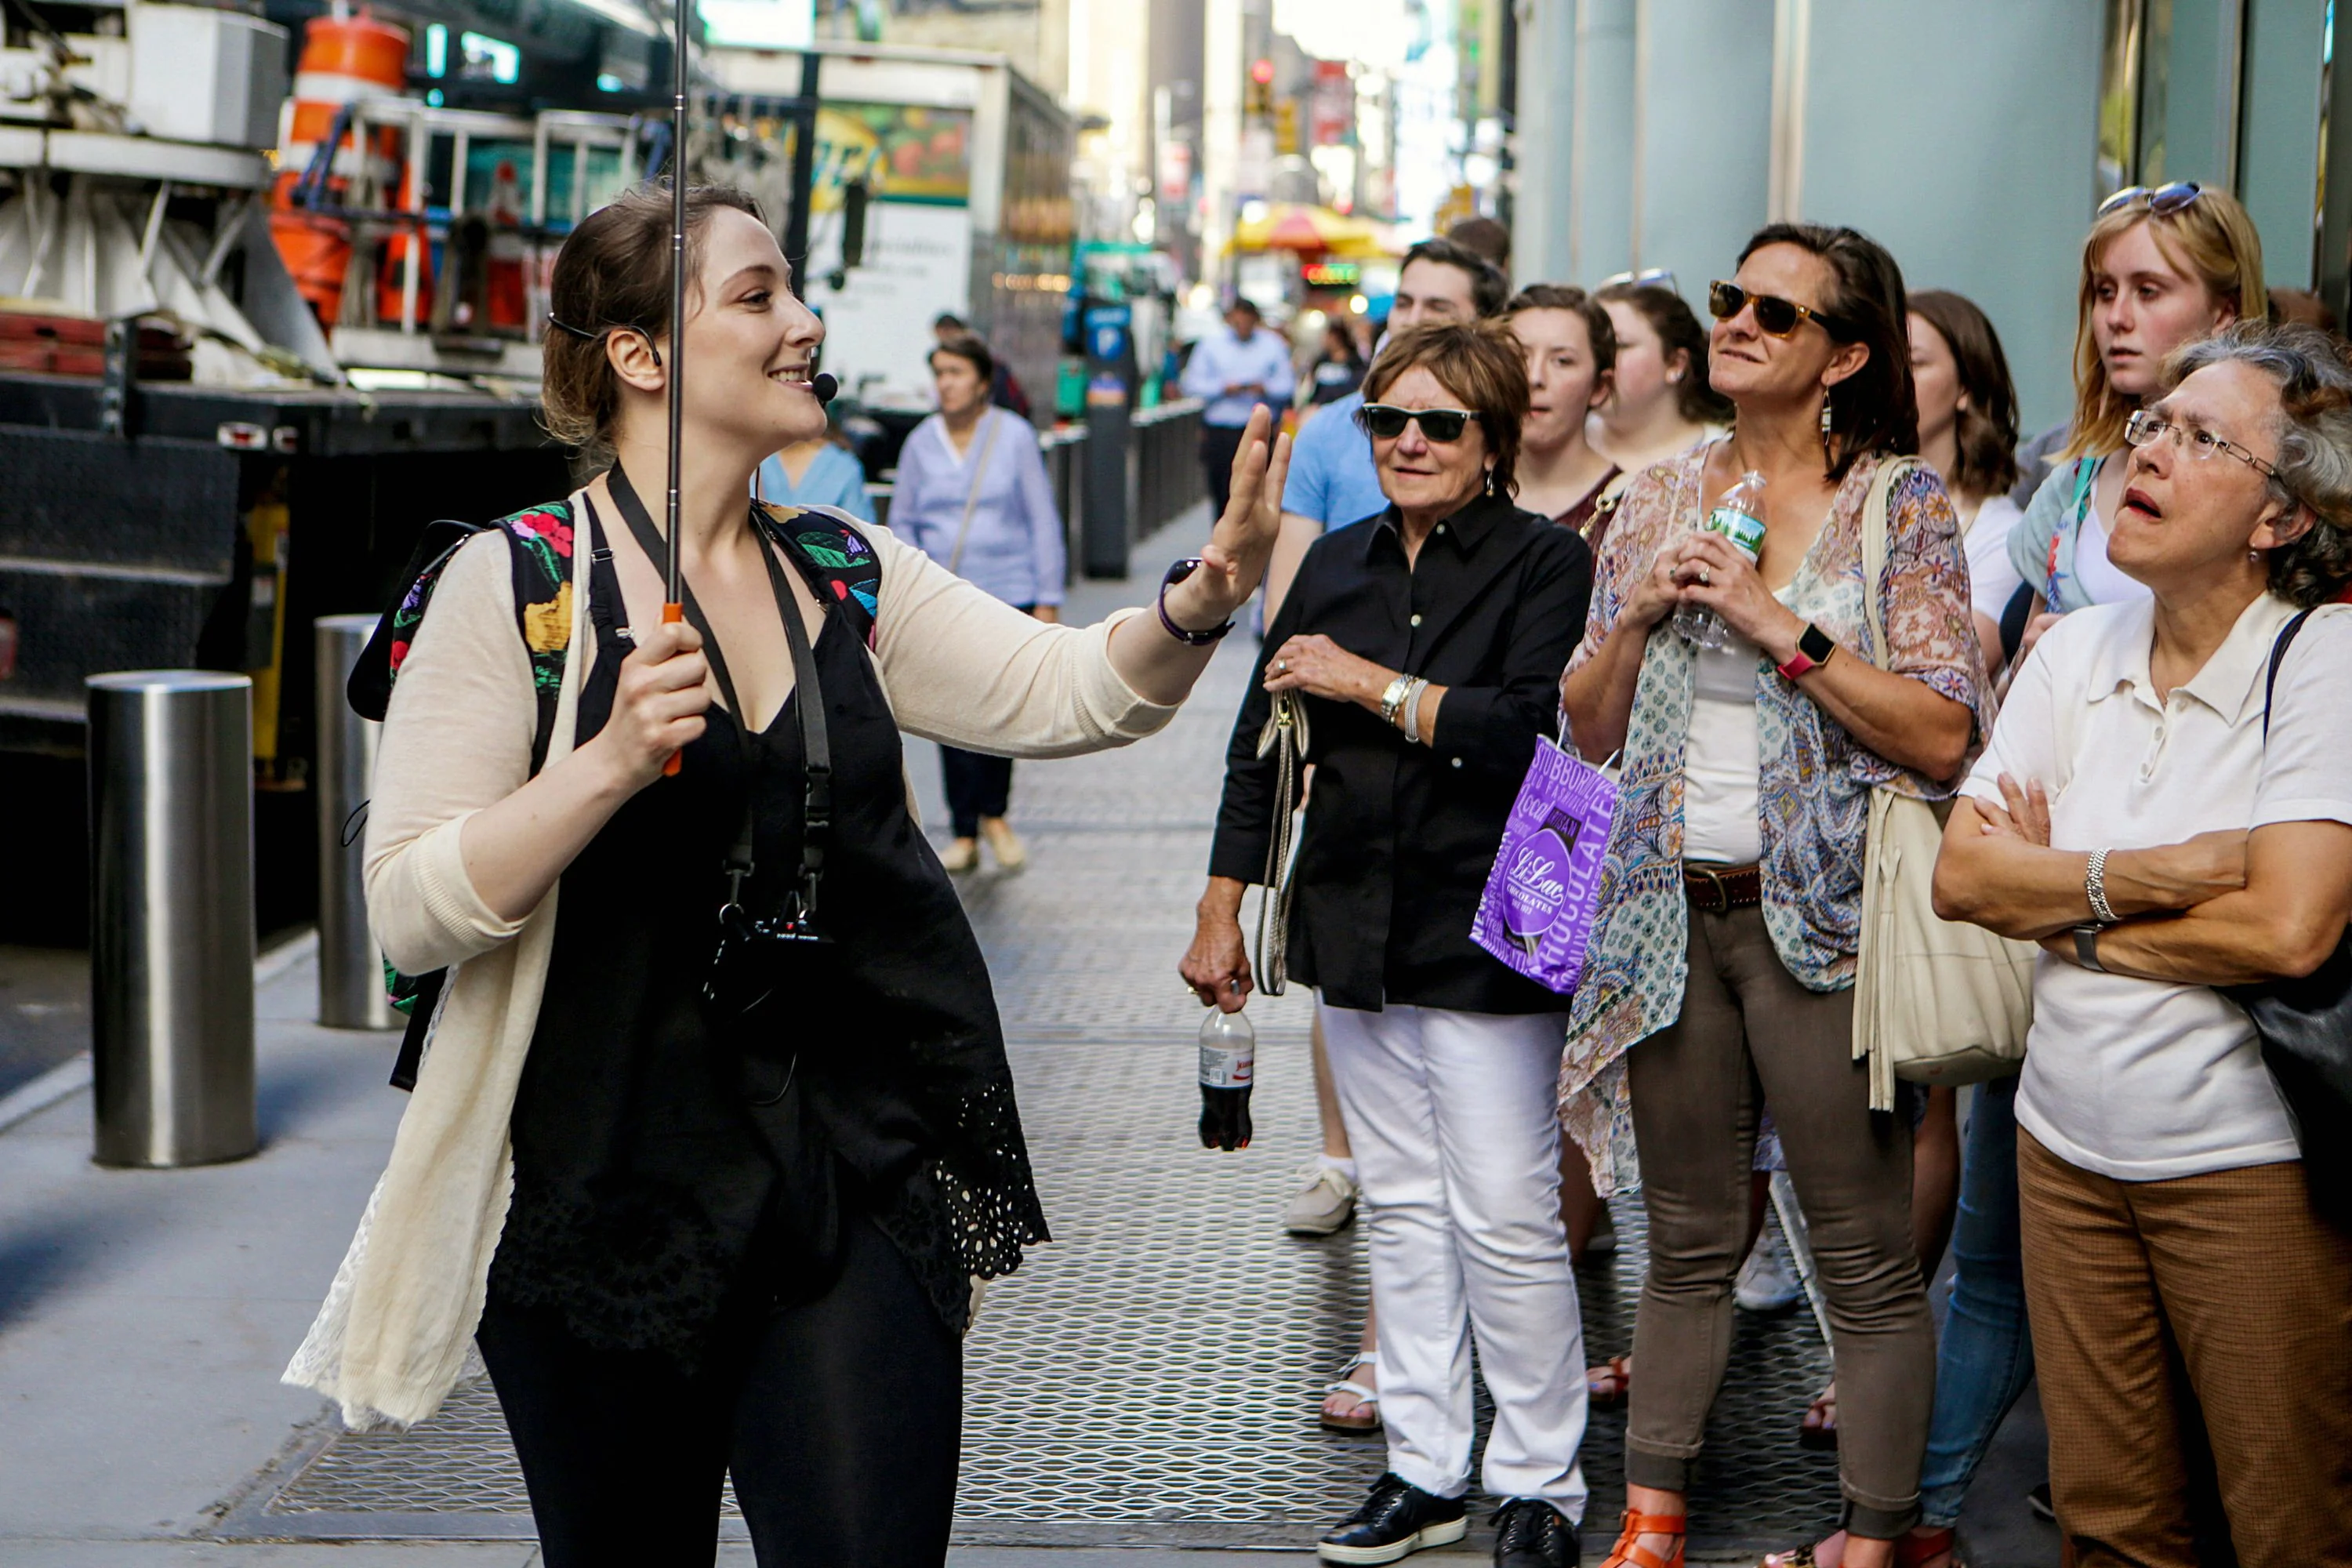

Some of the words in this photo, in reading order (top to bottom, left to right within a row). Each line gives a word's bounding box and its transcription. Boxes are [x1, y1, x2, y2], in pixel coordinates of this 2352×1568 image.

[1532, 742, 1605, 800] STUBBORNLY
[1517, 784, 1555, 823] Local
[1506, 884, 1553, 915] CHOCOLATES
[1540, 795, 1615, 966] HOCOLATE
